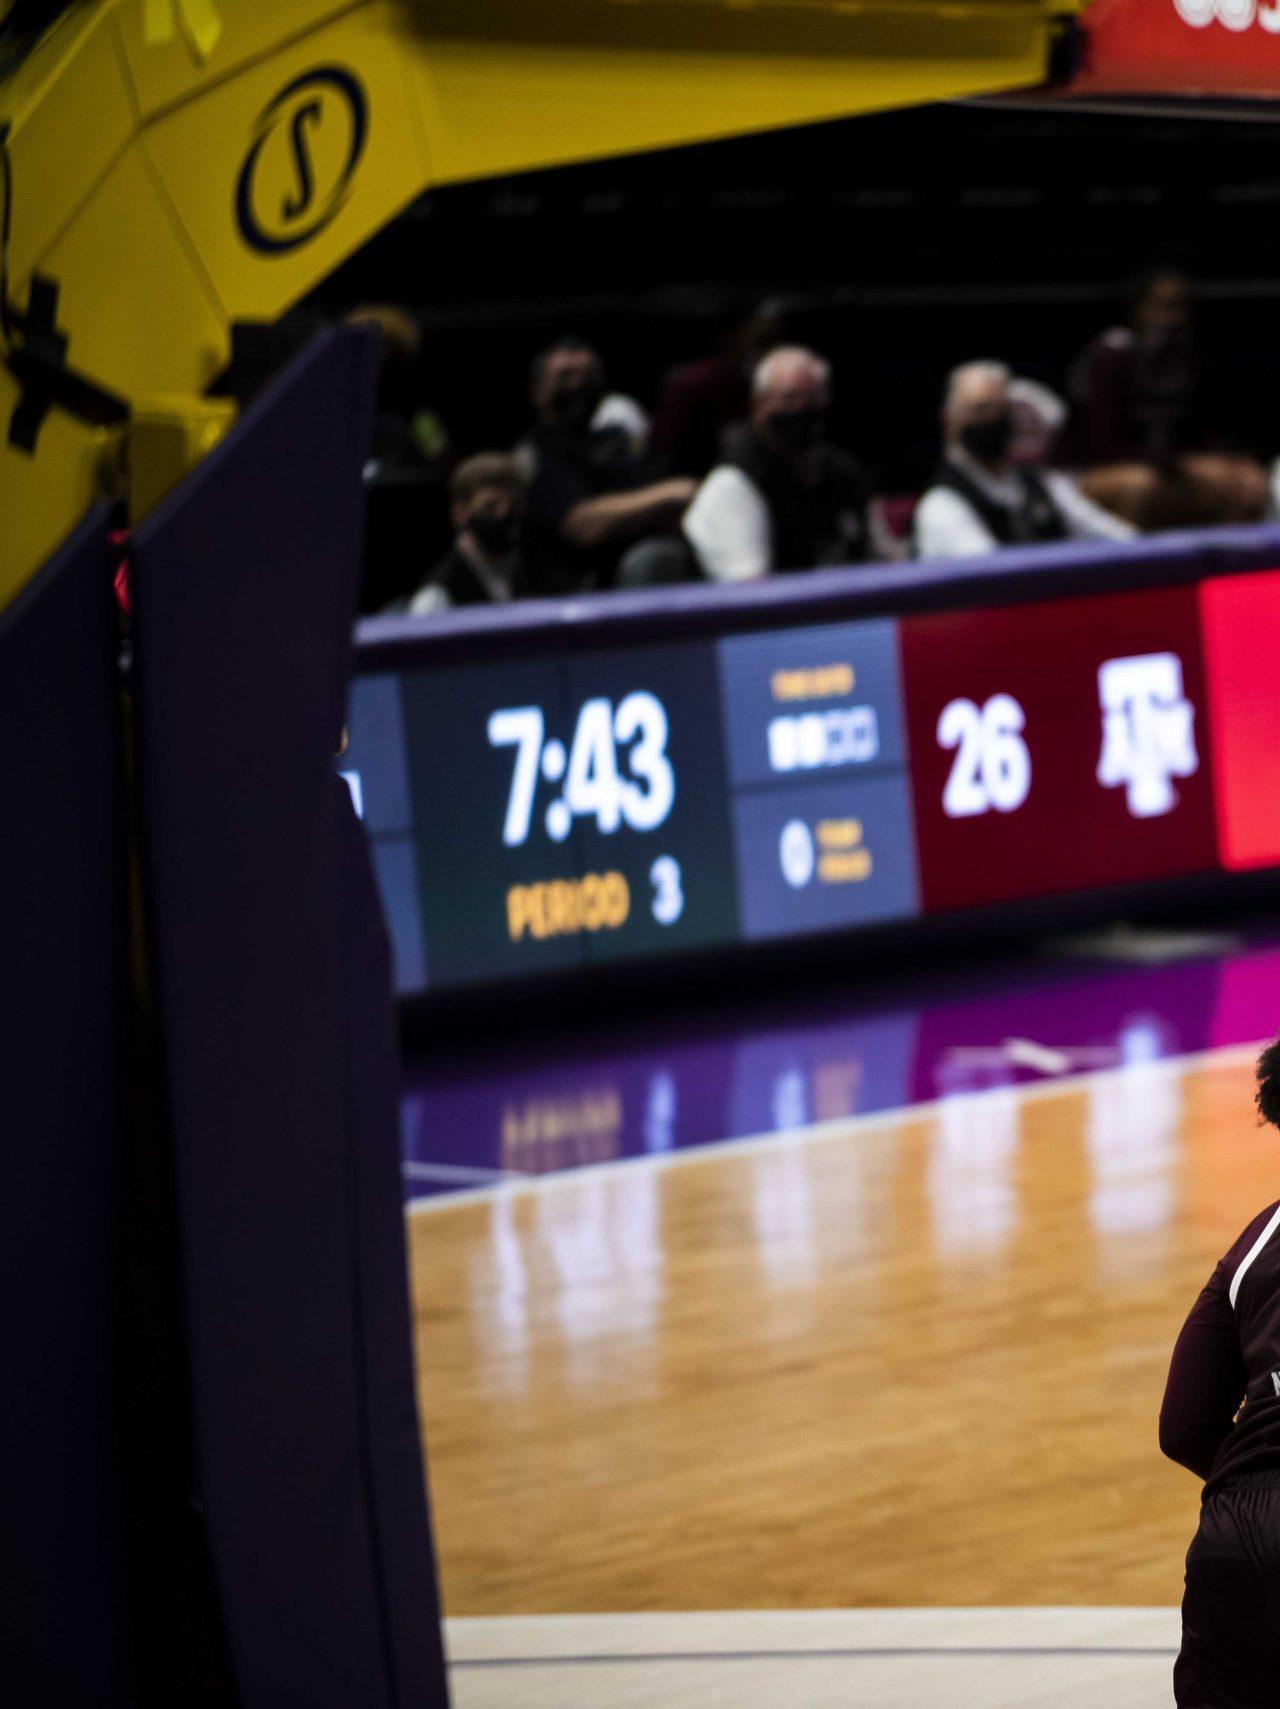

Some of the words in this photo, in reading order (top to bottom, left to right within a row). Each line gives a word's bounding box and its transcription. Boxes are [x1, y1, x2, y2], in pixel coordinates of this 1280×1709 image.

[487, 690, 676, 847] 7:43
[936, 692, 1032, 819] 26
[506, 870, 630, 942] PERIOD
[651, 856, 684, 927] 3
[779, 818, 814, 889] 0
